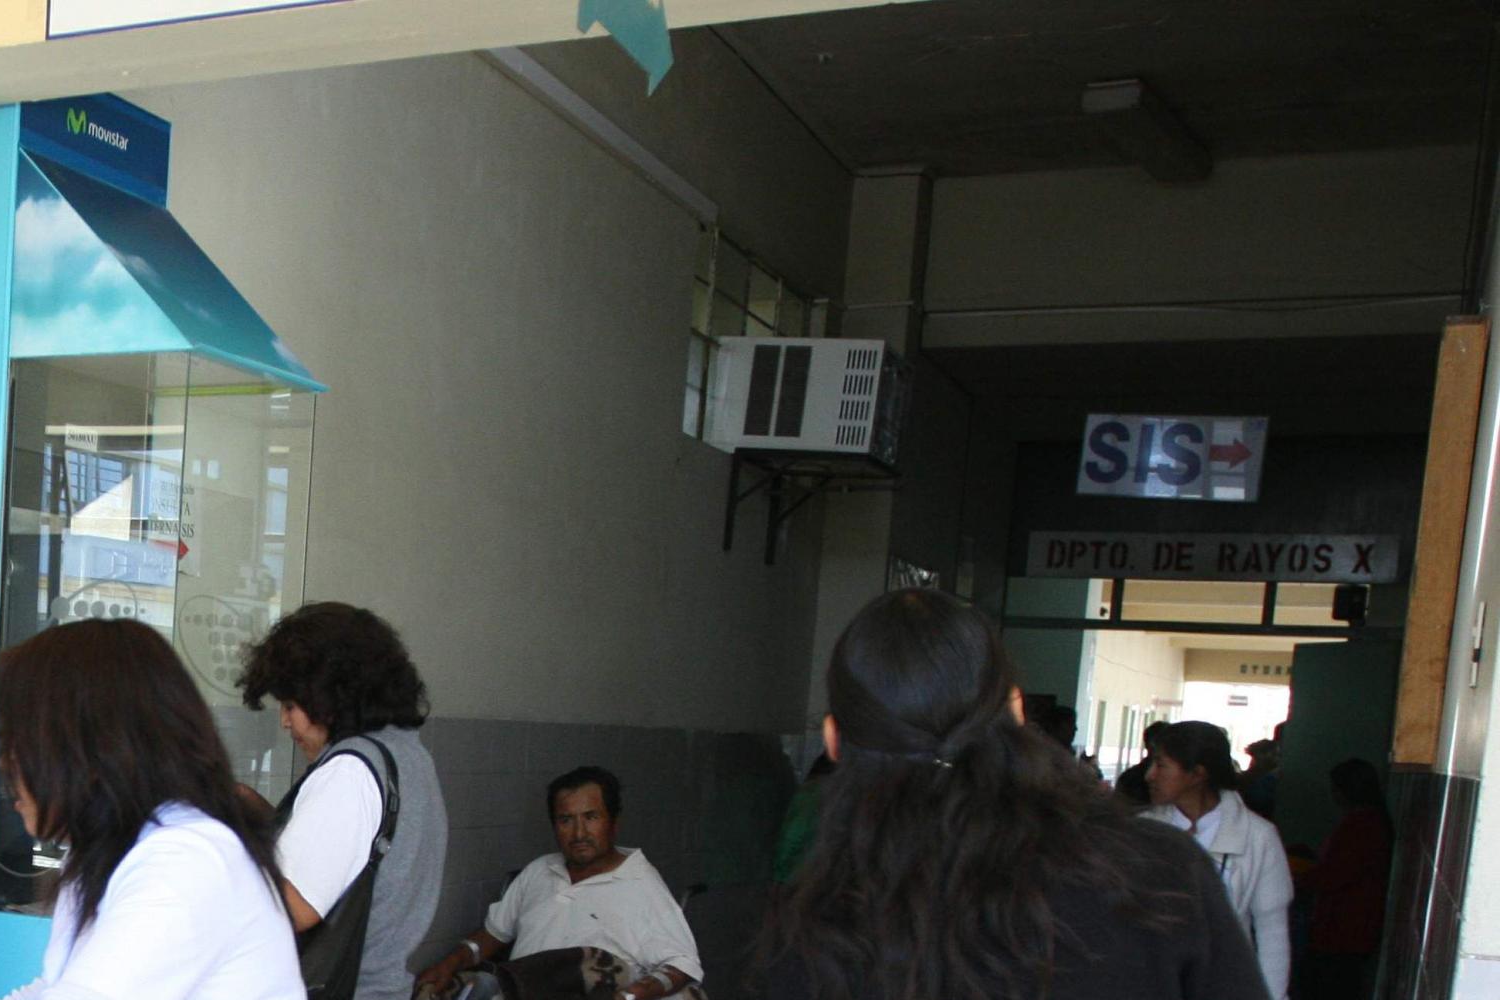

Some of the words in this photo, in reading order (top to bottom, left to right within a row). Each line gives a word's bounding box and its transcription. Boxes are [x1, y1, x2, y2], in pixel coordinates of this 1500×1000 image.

[88, 122, 129, 152] movistar
[1085, 421, 1204, 486] SIS
[1046, 539, 1136, 571] DPTO.
[1153, 541, 1196, 572] DE
[1217, 542, 1334, 574] RAYOS
[1352, 543, 1376, 575] X
